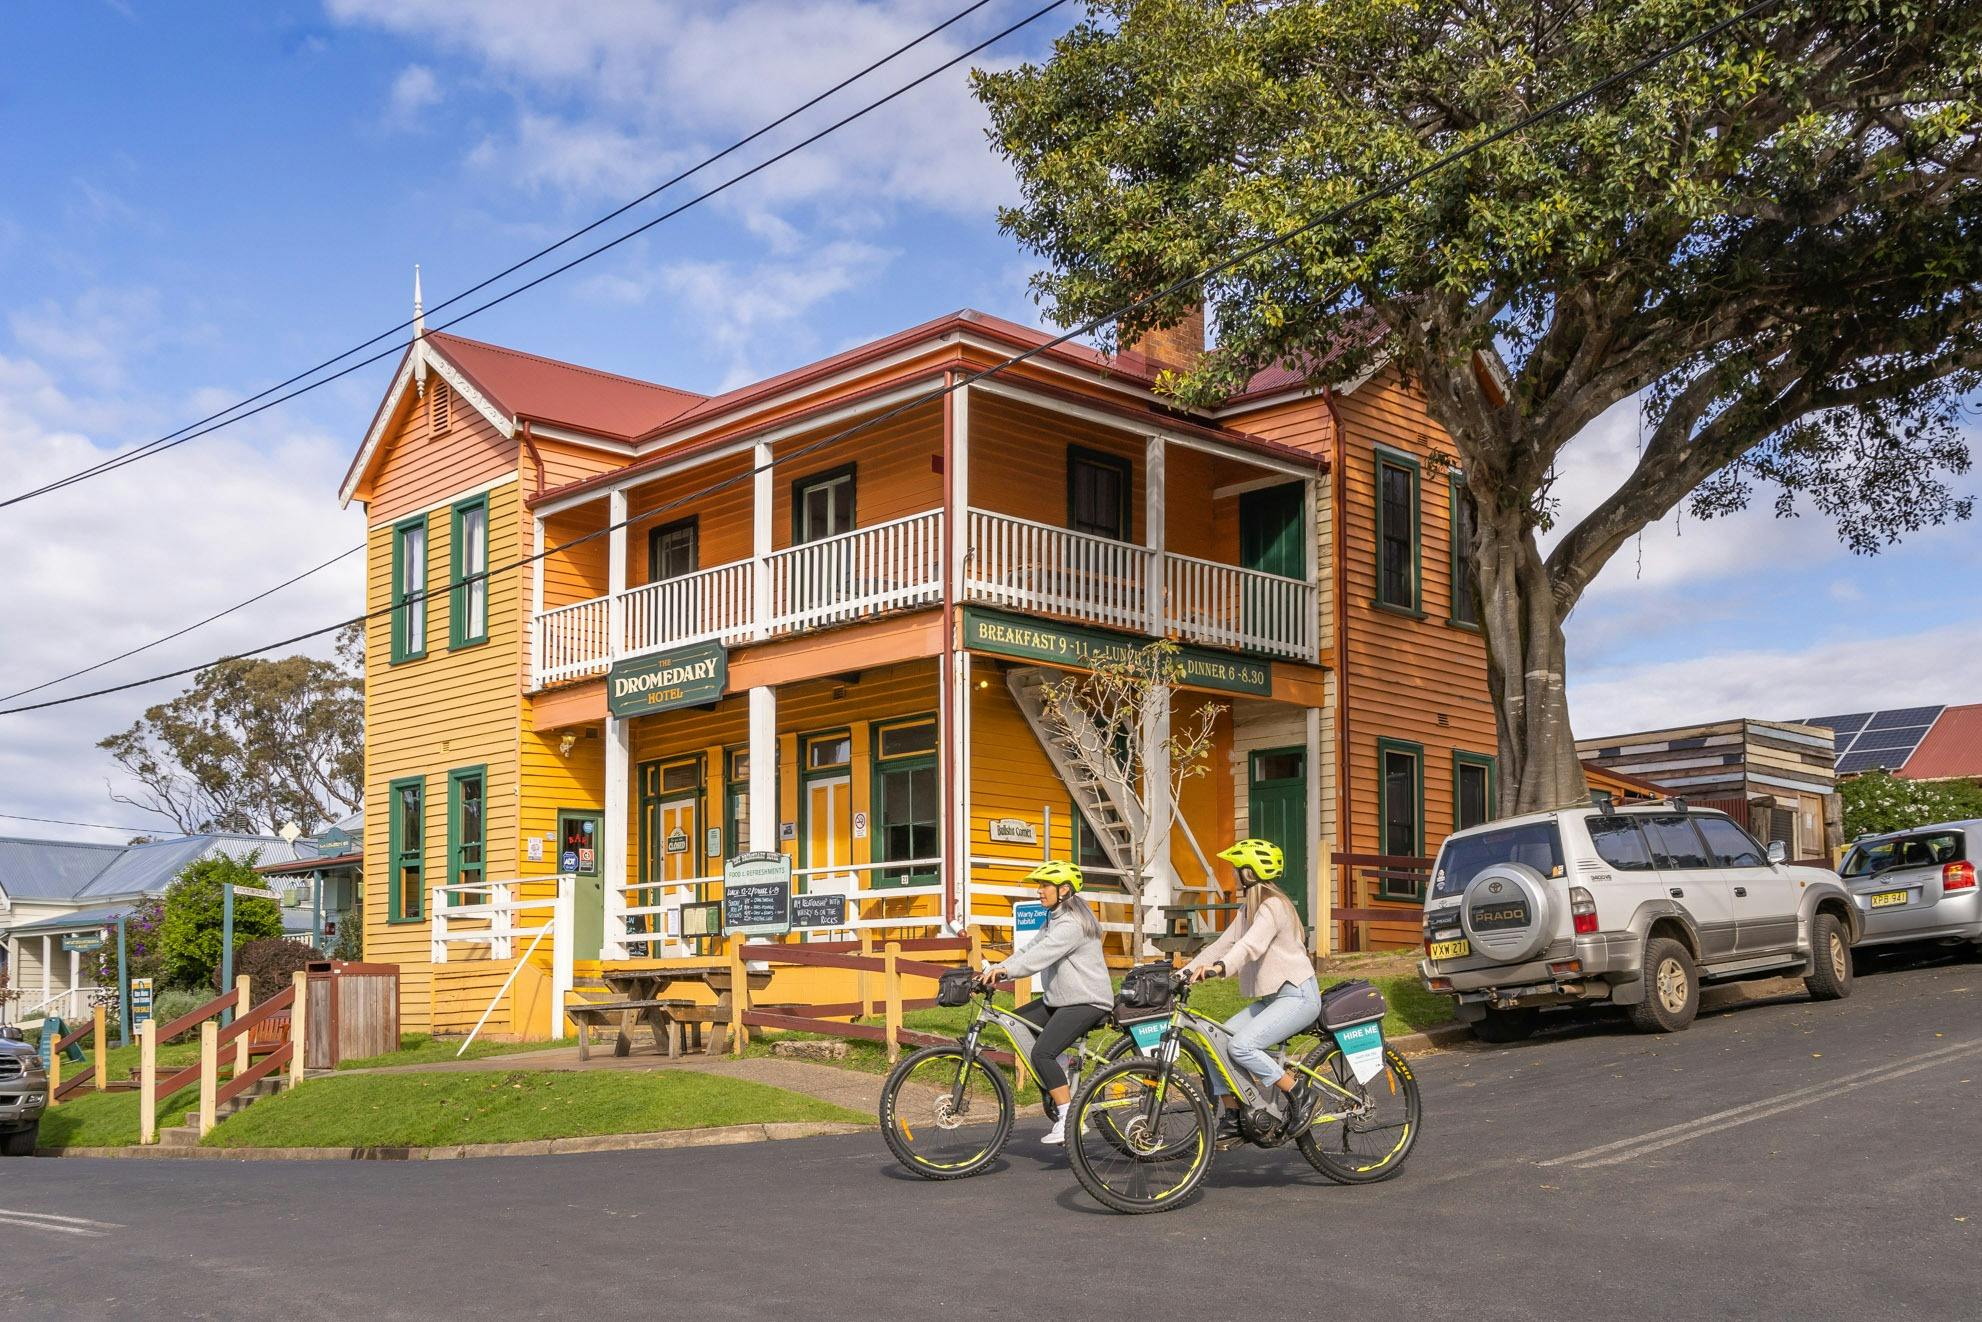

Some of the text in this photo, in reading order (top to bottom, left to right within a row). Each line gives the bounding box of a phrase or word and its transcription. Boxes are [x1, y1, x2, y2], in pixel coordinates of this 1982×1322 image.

[979, 622, 1056, 651] BREAKFAST
[1187, 659, 1225, 679] DINNER
[658, 659, 672, 668] THE
[615, 657, 719, 698] DROMEDARY
[647, 688, 684, 704] HOTEL
[1475, 909, 1524, 922] PRADO
[1432, 942, 1466, 956] VXW 271
[1138, 1025, 1159, 1035] HIRE
[1343, 1025, 1378, 1041] HIRE ME
[1387, 1050, 1412, 1080] MAXXIS
[1171, 1073, 1201, 1102] MAXXIS
